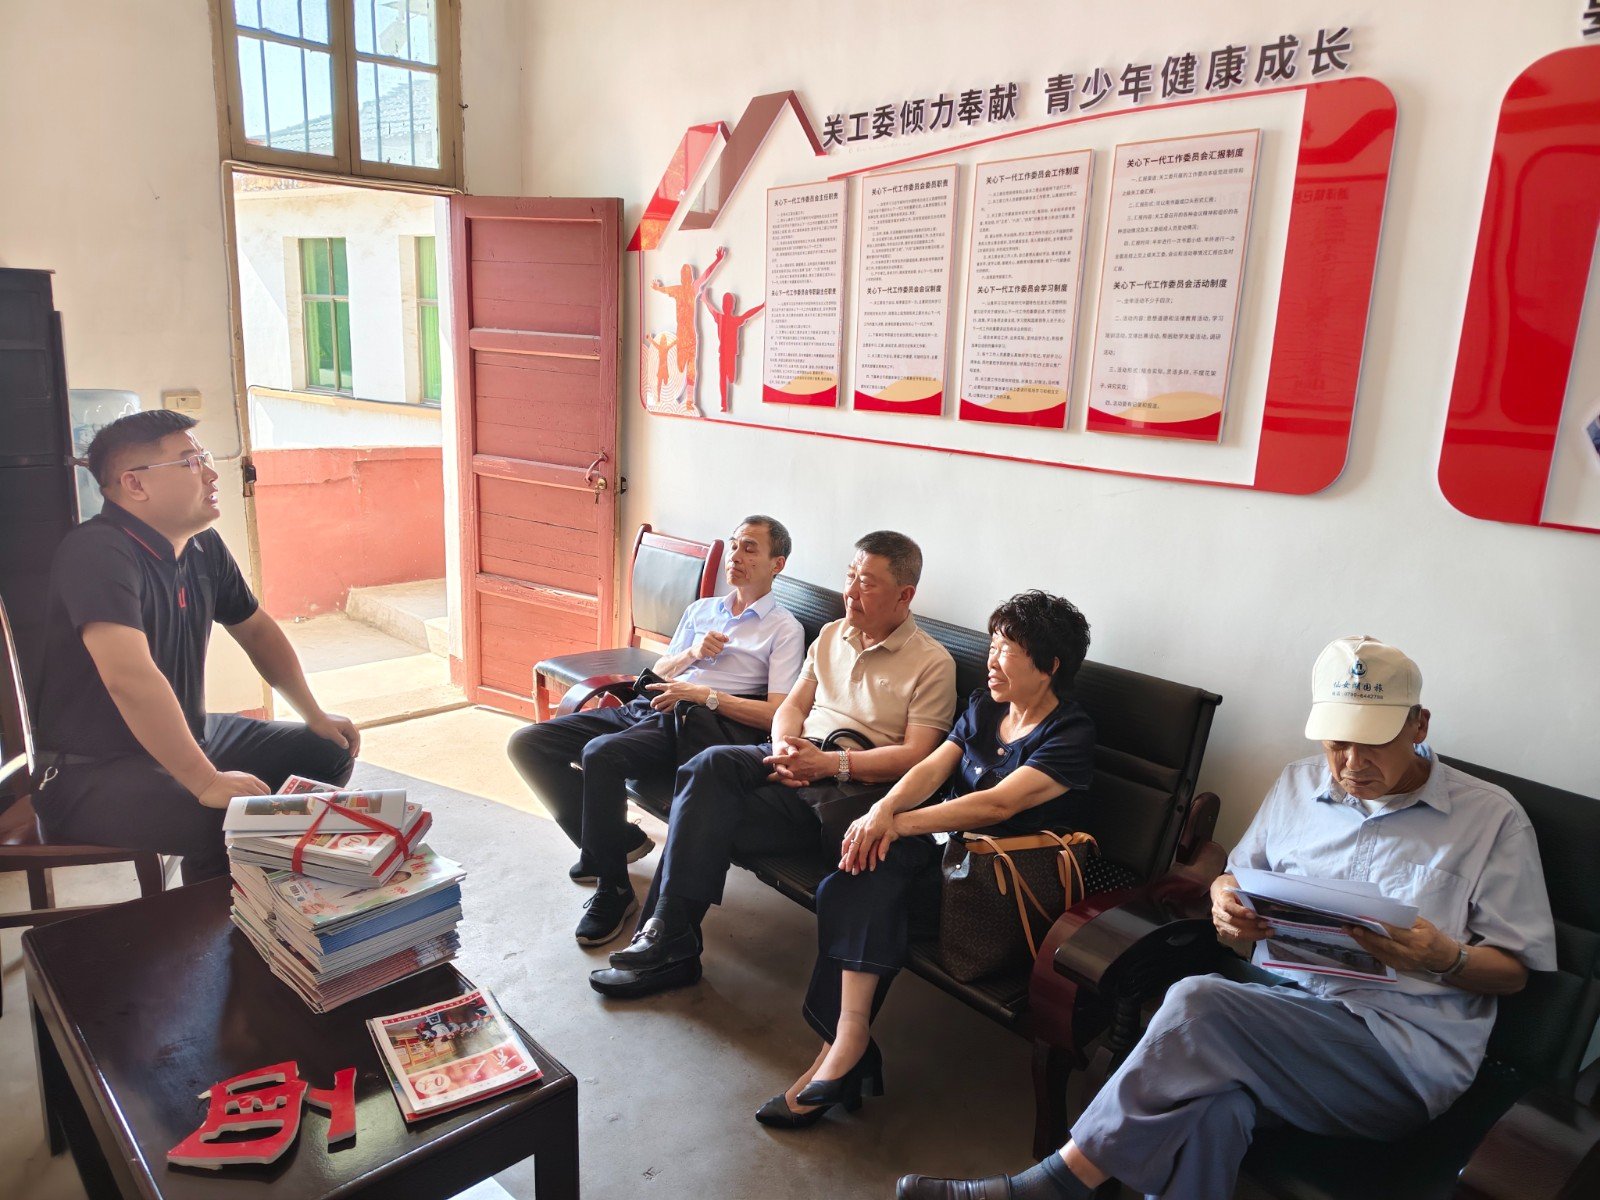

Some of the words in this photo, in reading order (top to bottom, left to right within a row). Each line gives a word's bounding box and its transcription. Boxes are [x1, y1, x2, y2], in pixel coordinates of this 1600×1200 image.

[822, 83, 1020, 147] 关工委倾力奉献
[1043, 27, 1352, 115] 青少年健康成长
[1126, 147, 1244, 168] 关心下一代工作委员会汇报制度
[986, 166, 1080, 185] 关心下一代工作委员会工作制度
[867, 284, 942, 294] 关心下一代工作委员会会议制度
[977, 284, 1068, 294] 关心下一代工作委员会学习制度
[1113, 279, 1228, 289] 关心下一代工作委员会活动制度
